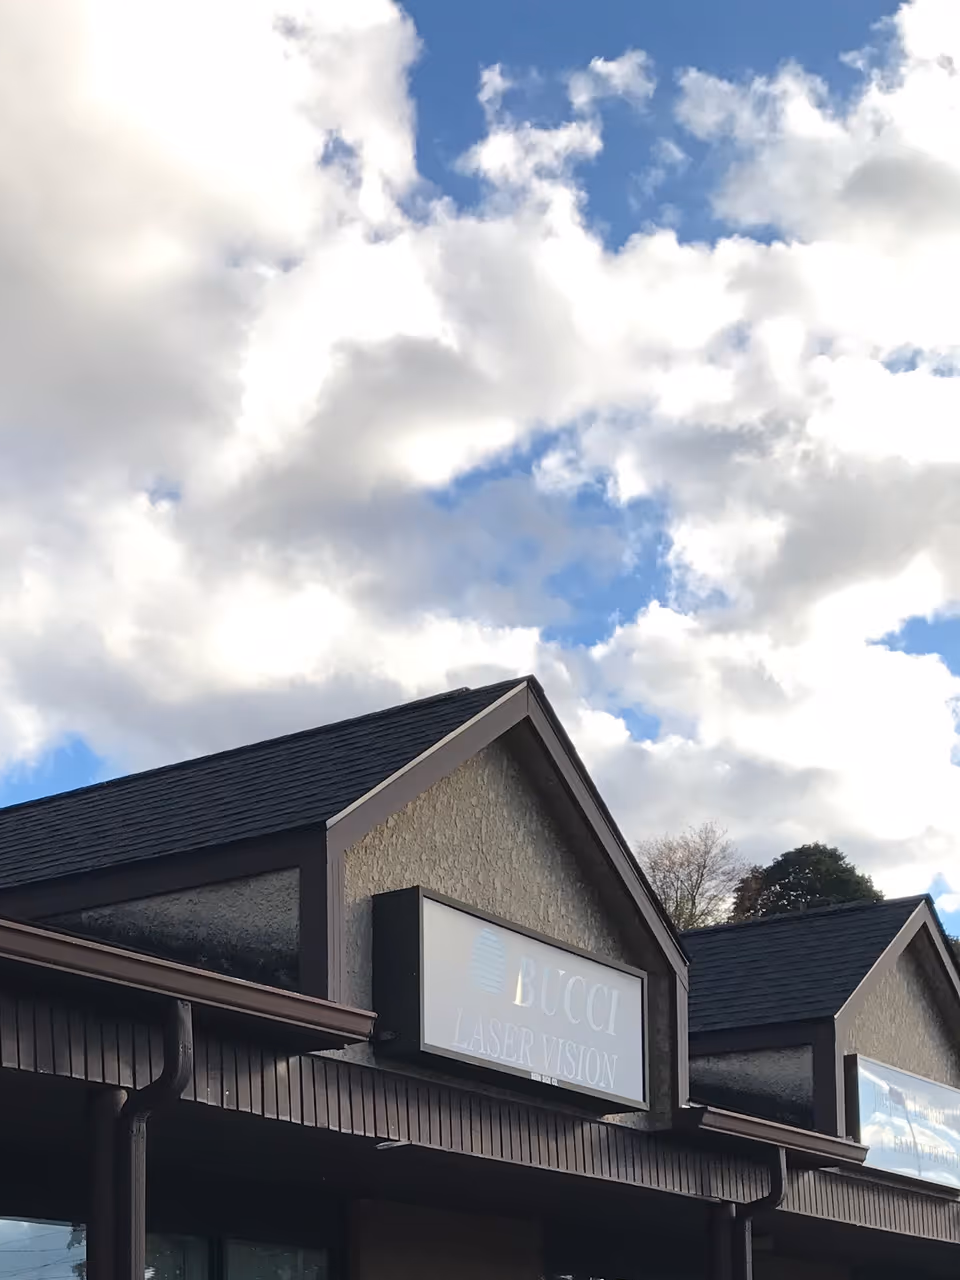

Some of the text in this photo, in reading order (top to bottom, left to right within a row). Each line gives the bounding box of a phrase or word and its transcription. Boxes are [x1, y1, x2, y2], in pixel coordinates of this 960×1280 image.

[512, 956, 621, 1036] BUCCI
[451, 1007, 619, 1089] LASER VISION
